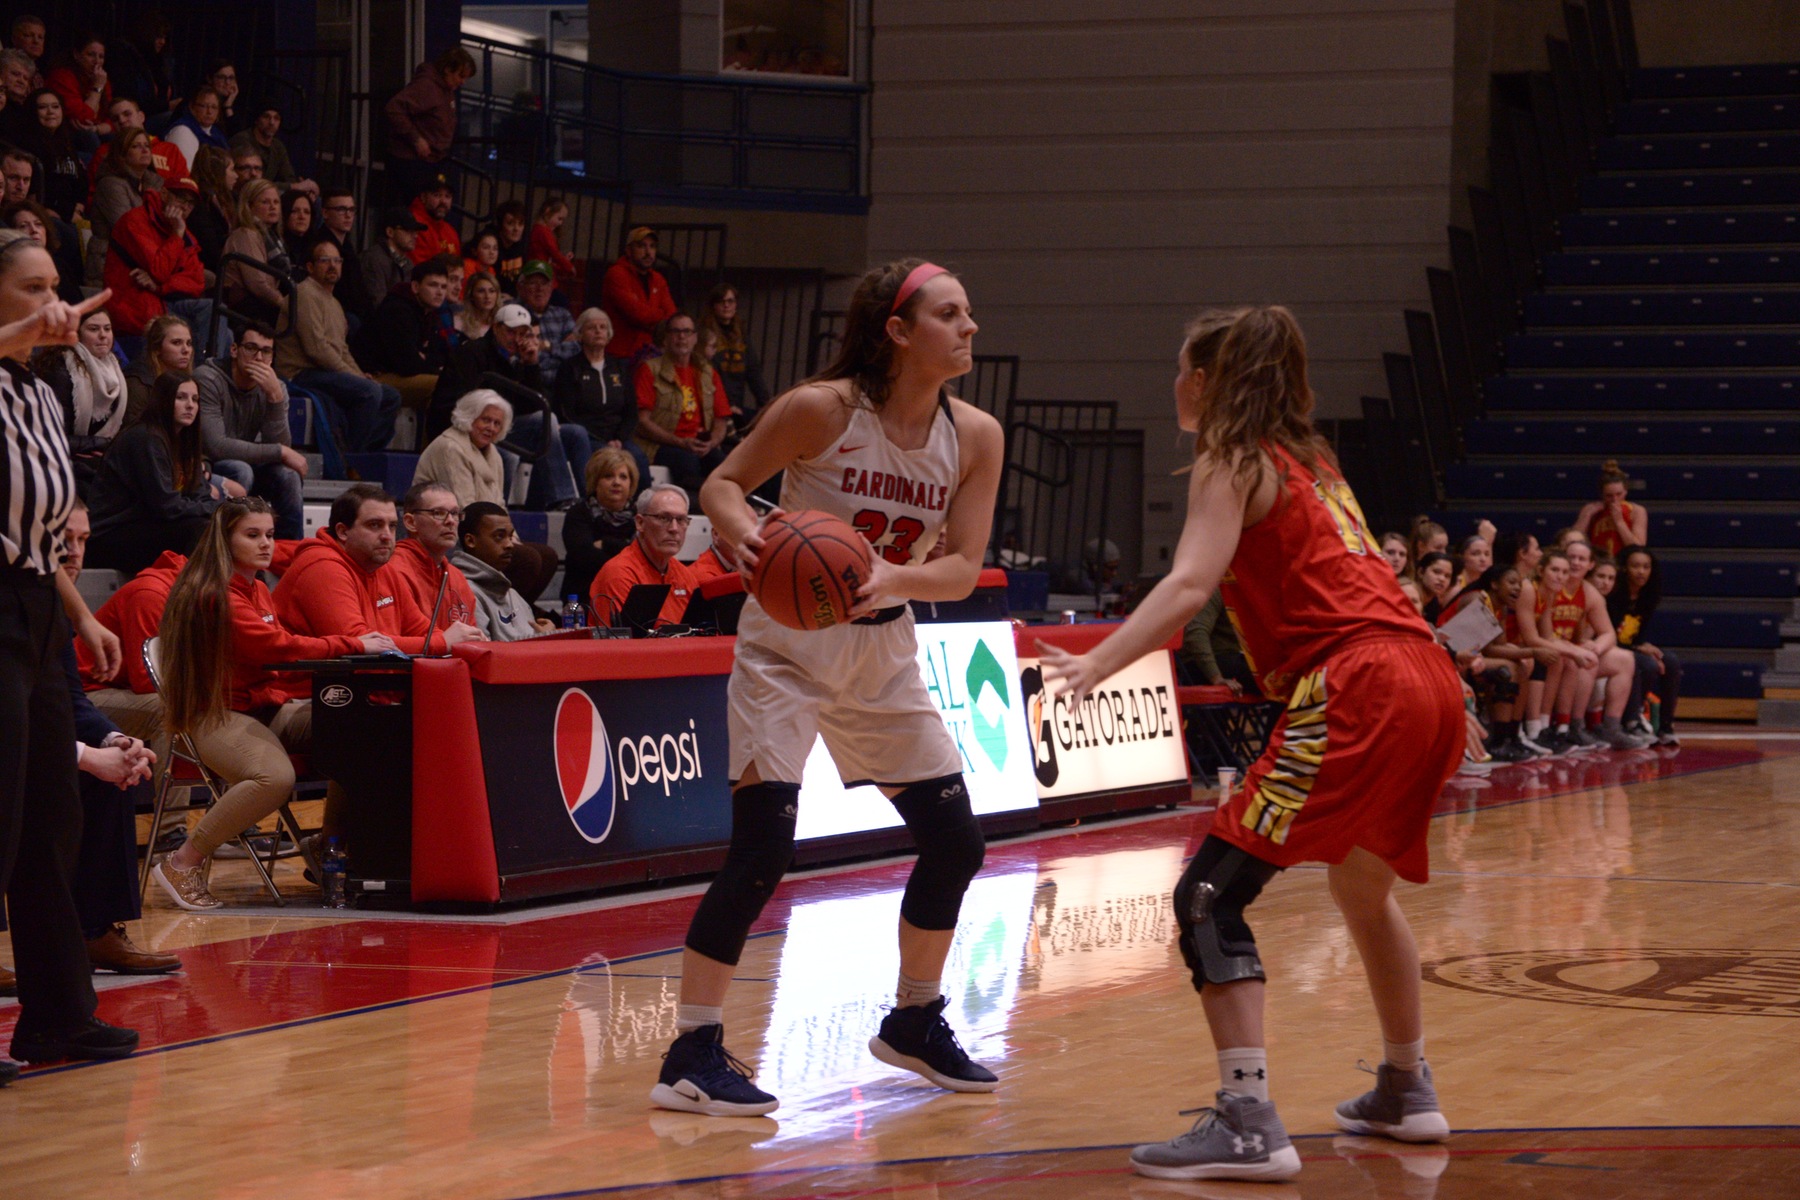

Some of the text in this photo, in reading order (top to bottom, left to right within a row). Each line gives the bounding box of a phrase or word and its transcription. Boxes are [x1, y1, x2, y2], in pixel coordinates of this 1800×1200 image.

[840, 467, 948, 511] CARDINALS
[853, 508, 925, 565] 23
[1053, 685, 1174, 752] GATORADE
[617, 717, 703, 801] pepsi
